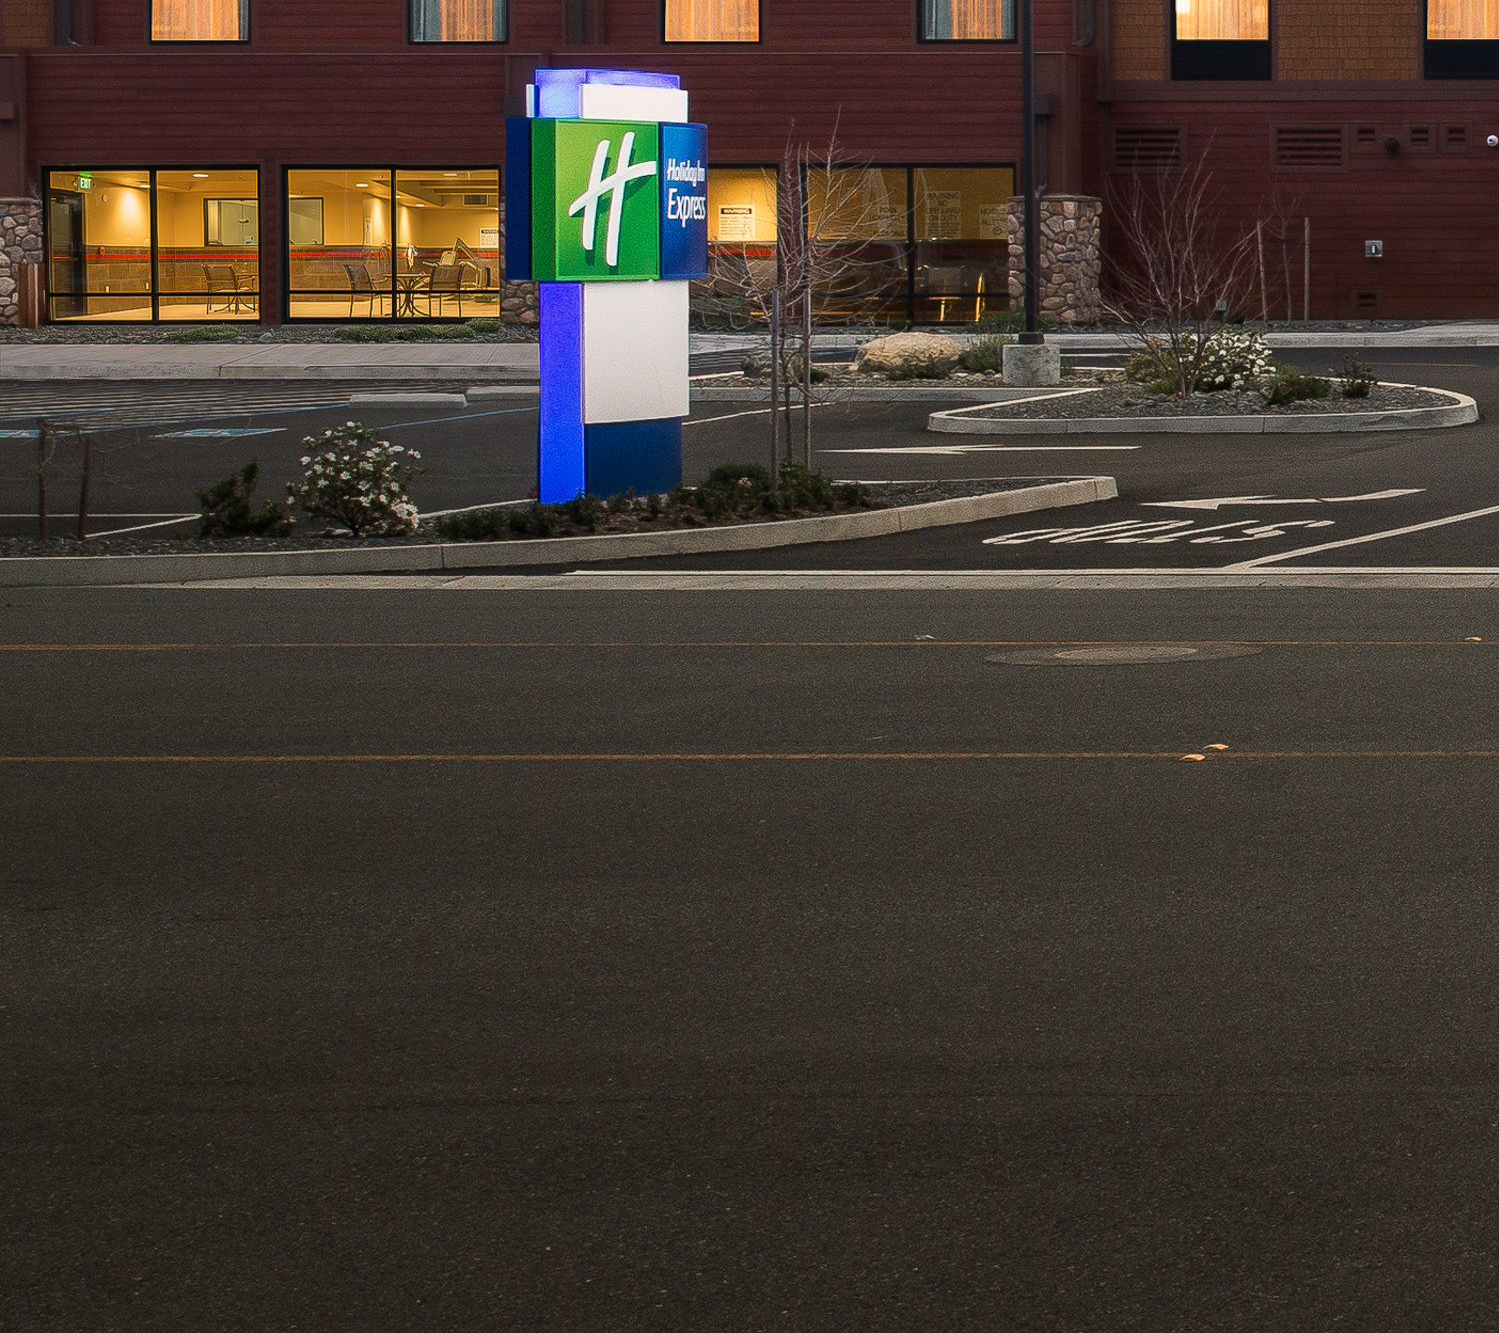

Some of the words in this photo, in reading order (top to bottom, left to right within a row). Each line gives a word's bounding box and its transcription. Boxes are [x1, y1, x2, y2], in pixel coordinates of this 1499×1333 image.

[666, 158, 697, 188] Holiday
[667, 187, 706, 228] Express
[981, 519, 1335, 545] STOP
